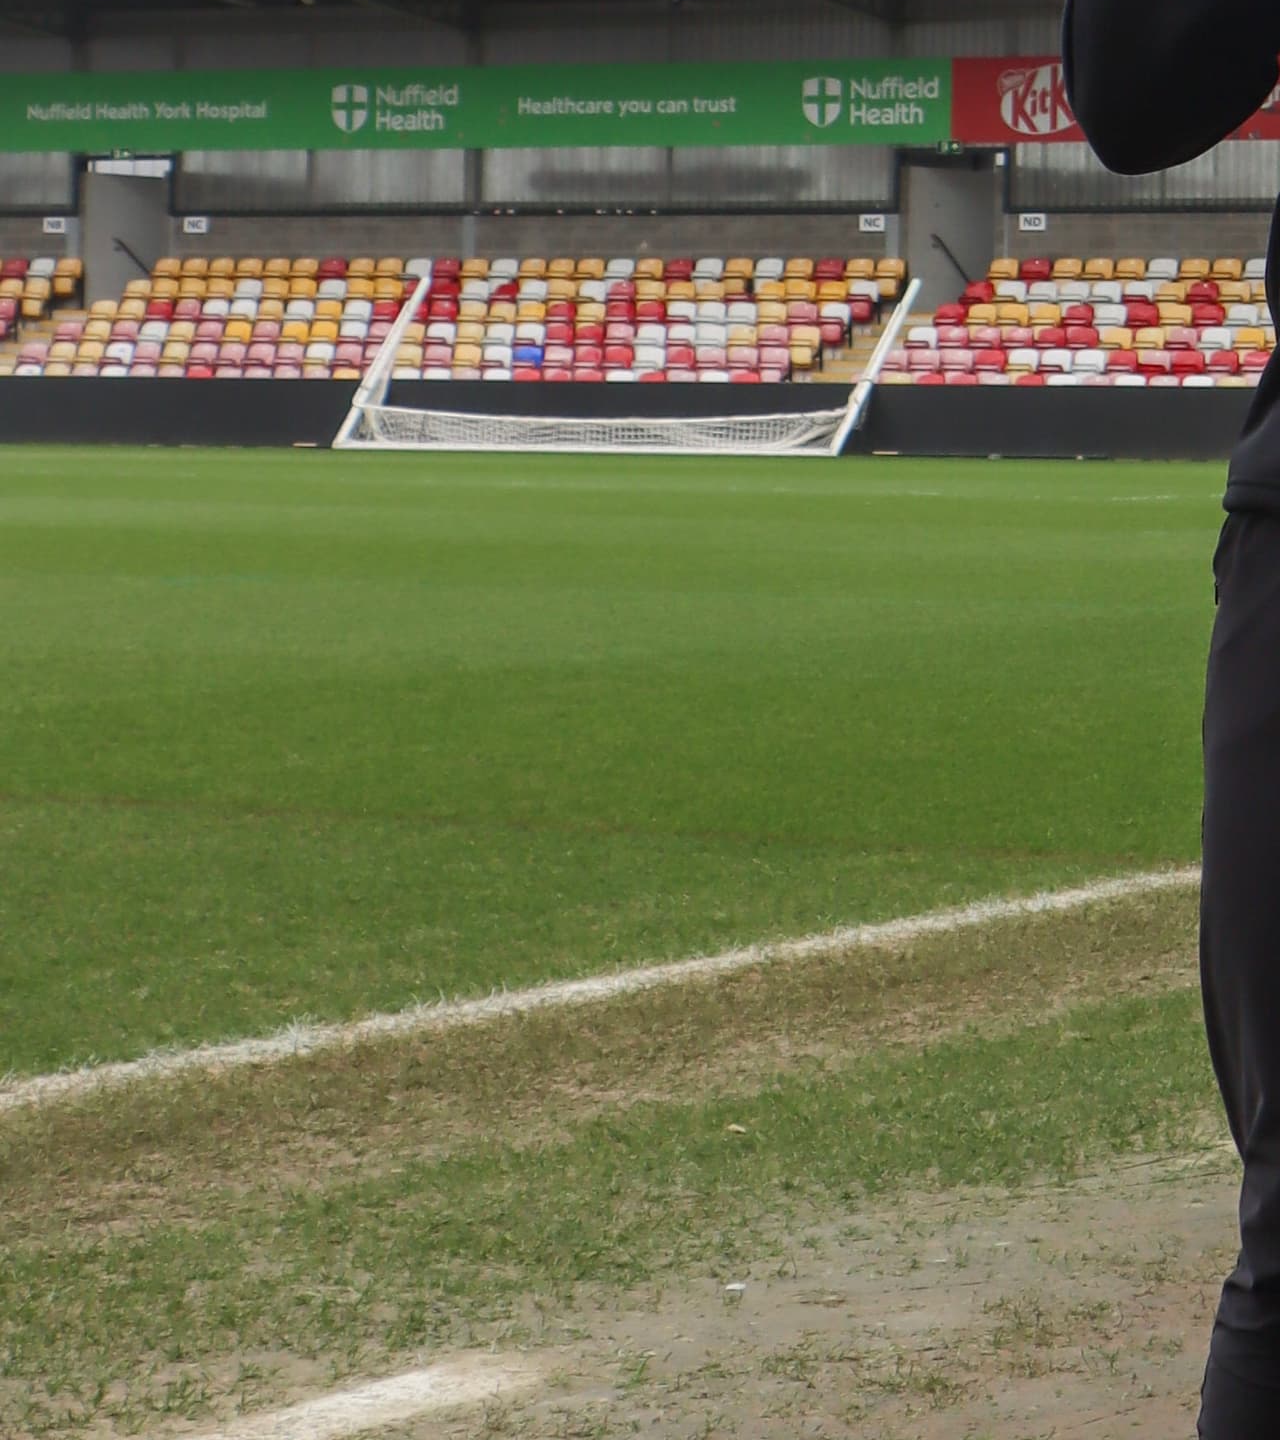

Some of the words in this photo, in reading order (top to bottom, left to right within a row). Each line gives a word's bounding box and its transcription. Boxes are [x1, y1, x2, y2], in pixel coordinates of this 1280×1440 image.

[376, 84, 458, 106] Nuffield
[849, 76, 940, 99] Nuffield
[26, 102, 91, 120] Nuffield
[95, 102, 149, 120] Health
[154, 102, 190, 119] York
[196, 100, 267, 123] Hospital
[517, 97, 613, 115] Healthcare
[618, 98, 651, 118] you
[656, 98, 688, 114] can
[693, 96, 737, 113] trust
[849, 102, 924, 125] Health
[376, 109, 444, 131] Health
[863, 217, 881, 228] NC
[1023, 216, 1042, 227] ND
